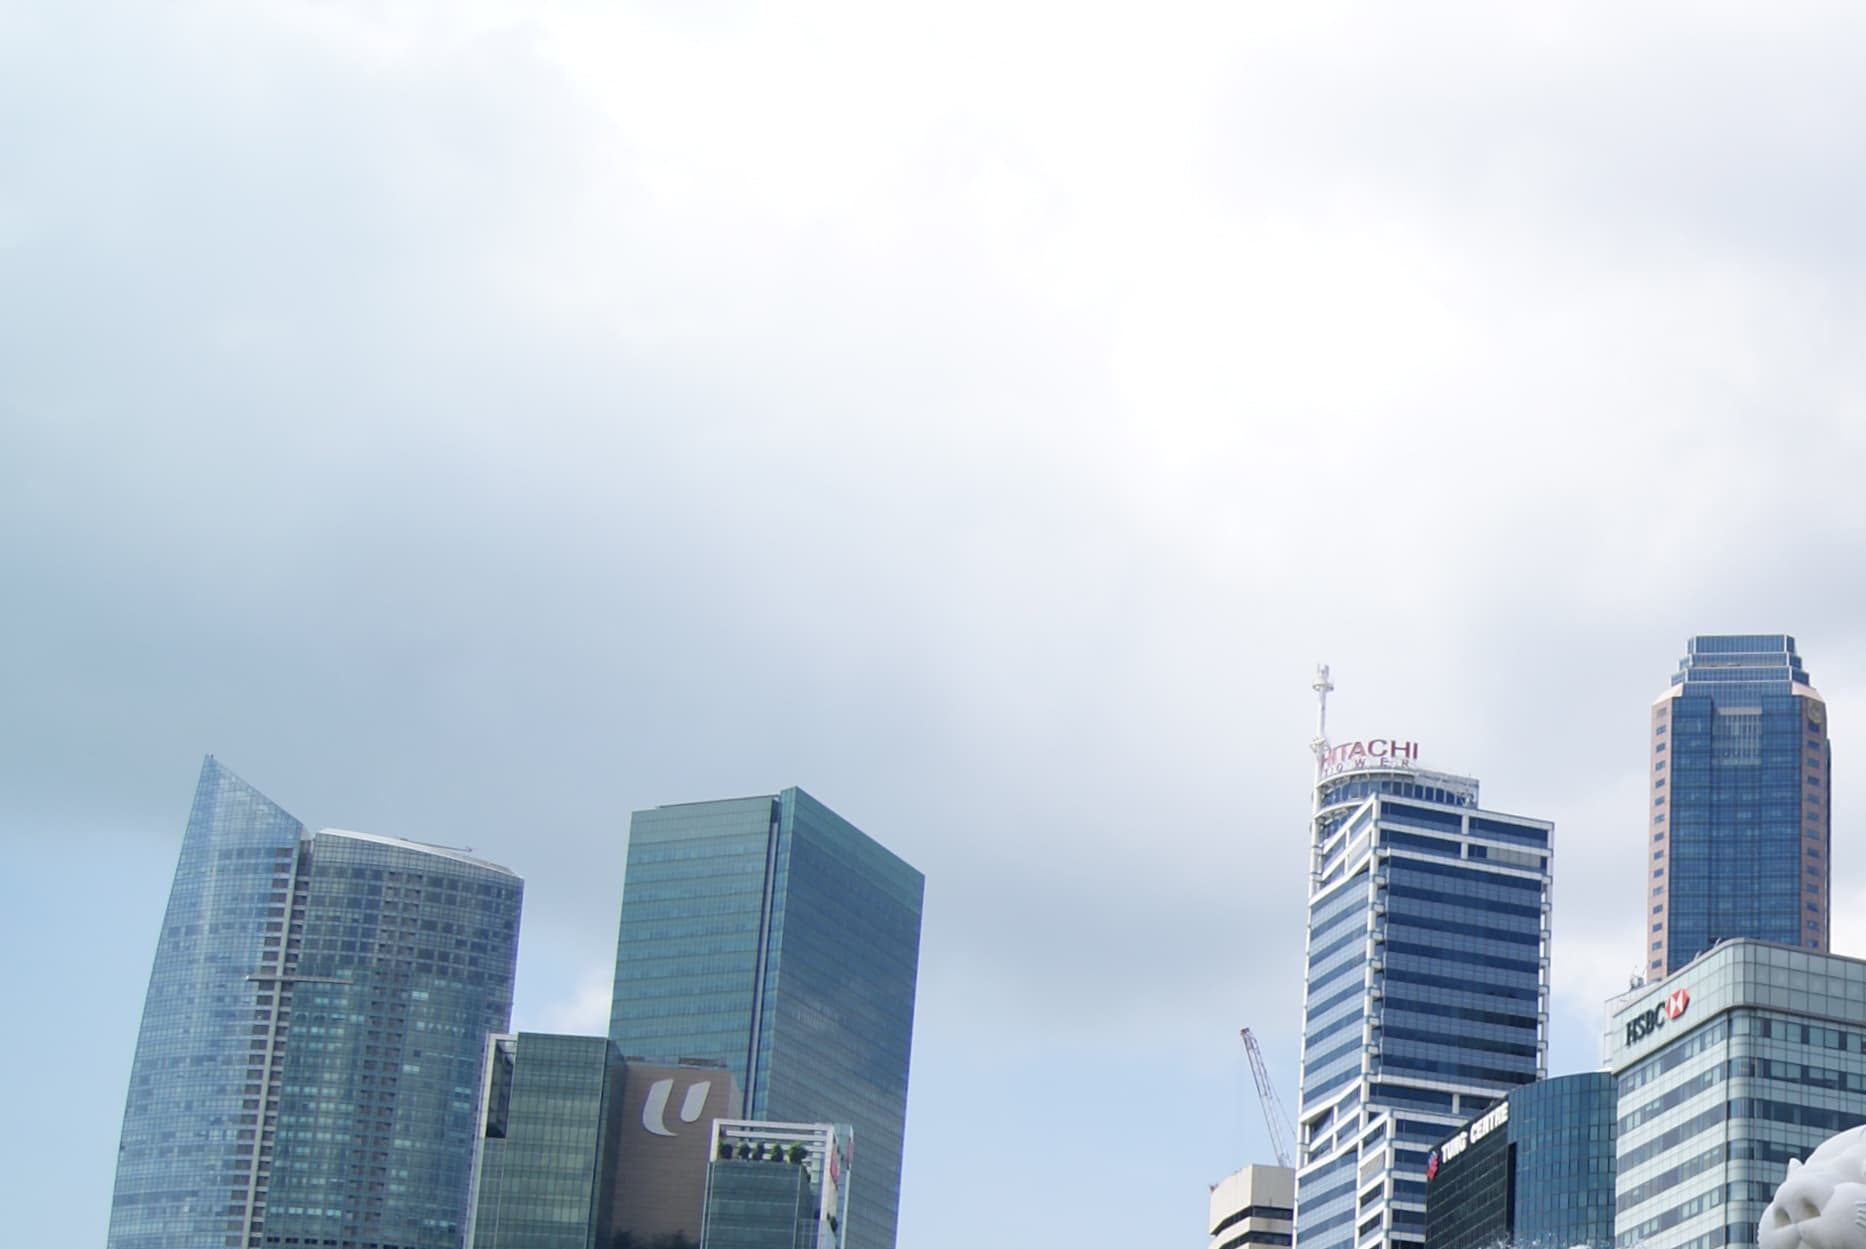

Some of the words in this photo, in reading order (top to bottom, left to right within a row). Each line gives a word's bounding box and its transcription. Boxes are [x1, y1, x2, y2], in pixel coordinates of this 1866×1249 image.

[1321, 738, 1419, 776] HITACHI
[1625, 1001, 1666, 1047] HSBC
[1470, 1101, 1509, 1144] CENTRE
